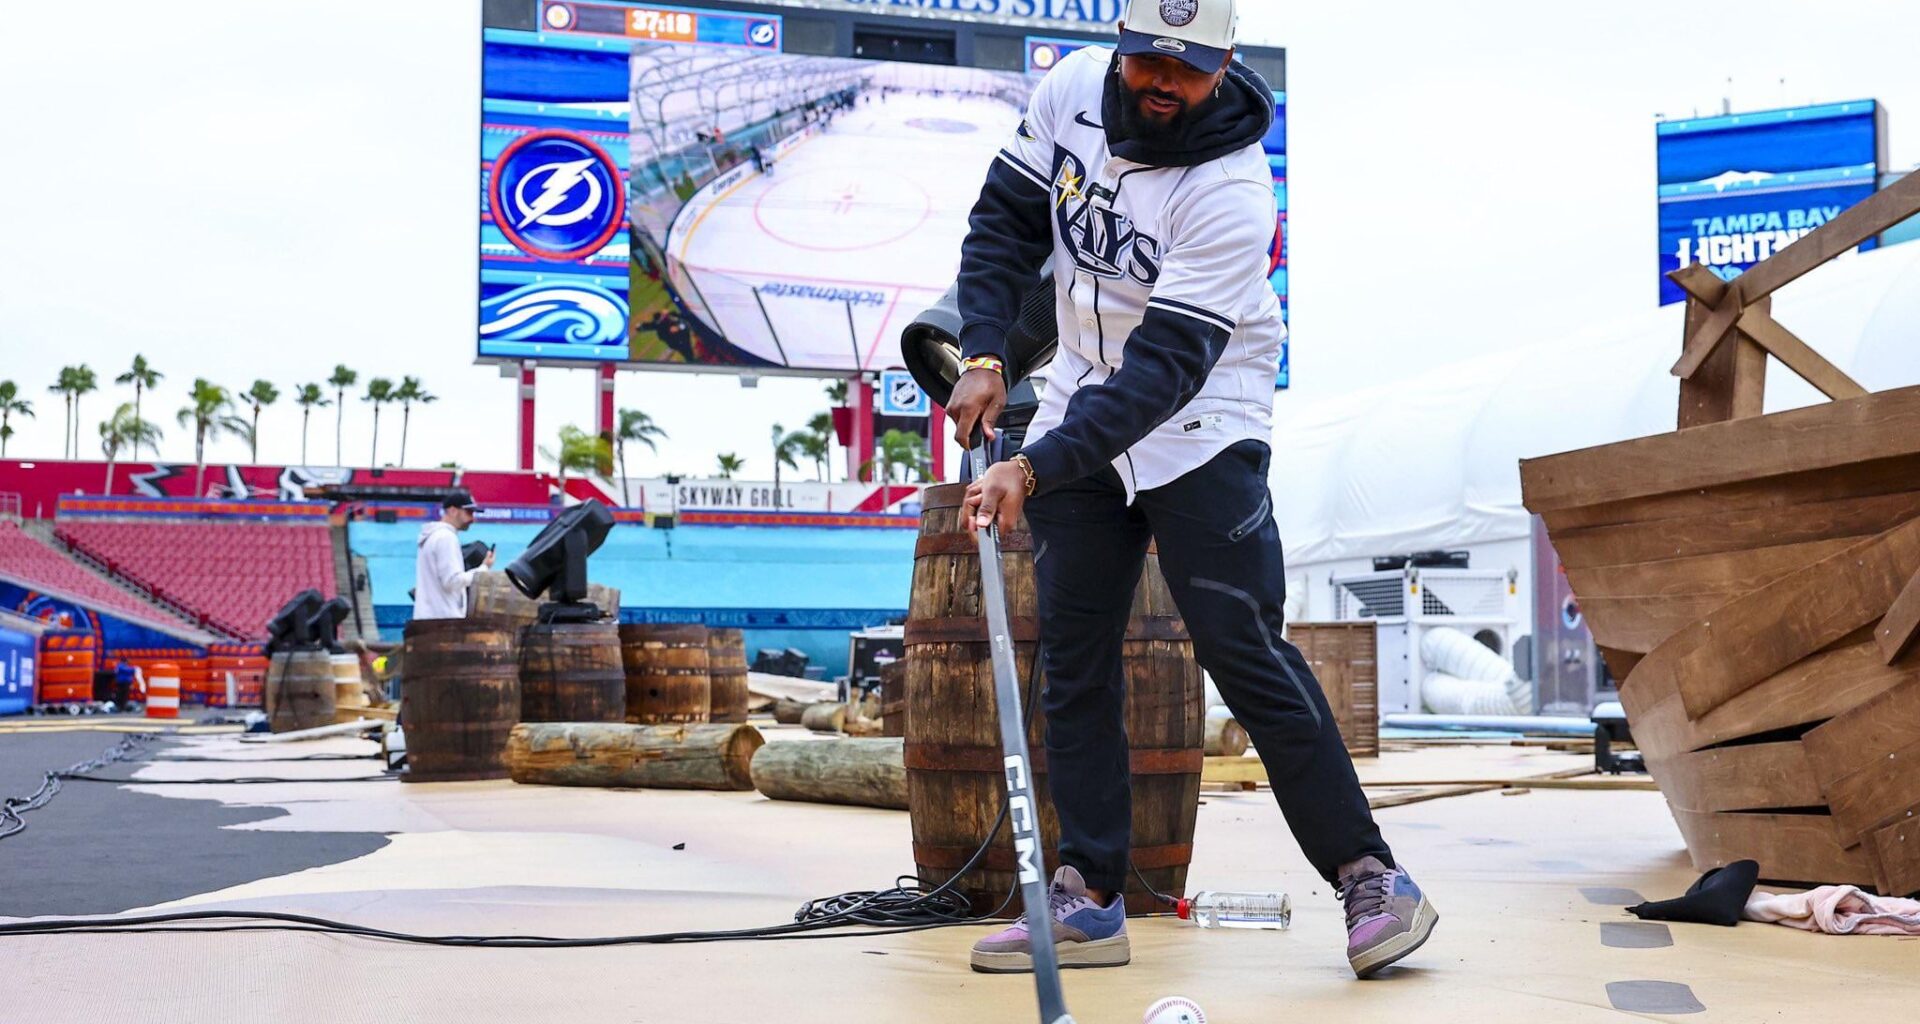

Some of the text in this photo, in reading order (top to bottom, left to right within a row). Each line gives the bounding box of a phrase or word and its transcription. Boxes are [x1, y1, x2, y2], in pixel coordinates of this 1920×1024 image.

[631, 9, 692, 35] 37:18
[1051, 140, 1162, 287] RAYS
[1692, 205, 1842, 236] TAMPA BAY
[678, 486, 744, 507] SKYWAY
[645, 608, 748, 625] STADIUM SERIES
[1004, 754, 1040, 884] CCM
